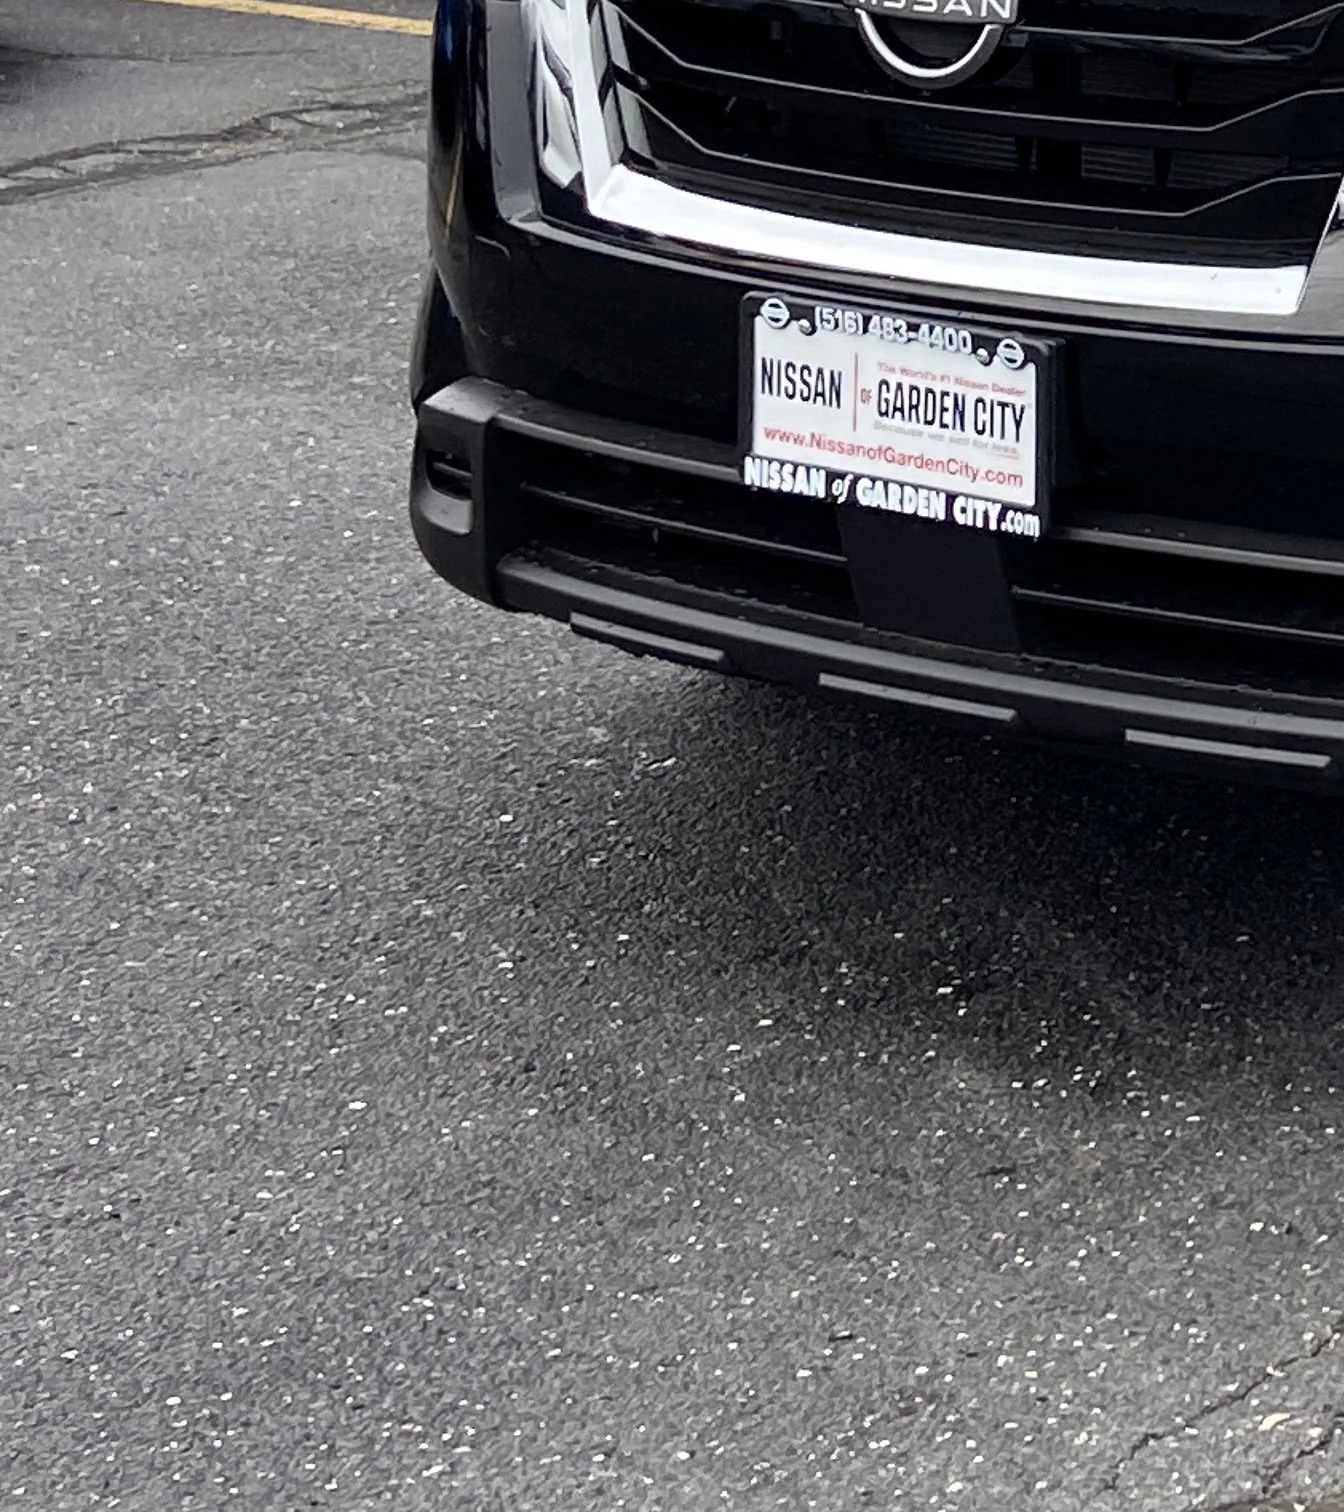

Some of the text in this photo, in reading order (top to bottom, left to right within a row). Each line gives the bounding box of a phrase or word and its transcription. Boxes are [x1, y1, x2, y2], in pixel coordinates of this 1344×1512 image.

[814, 305, 973, 355] (516) 483-4400
[761, 356, 1026, 443] NISSAN OF GARDEN CITY
[763, 426, 1024, 488] www.NissanofGardenCity.com
[743, 455, 1041, 539] NISSAN of GARDEN CITY.com
